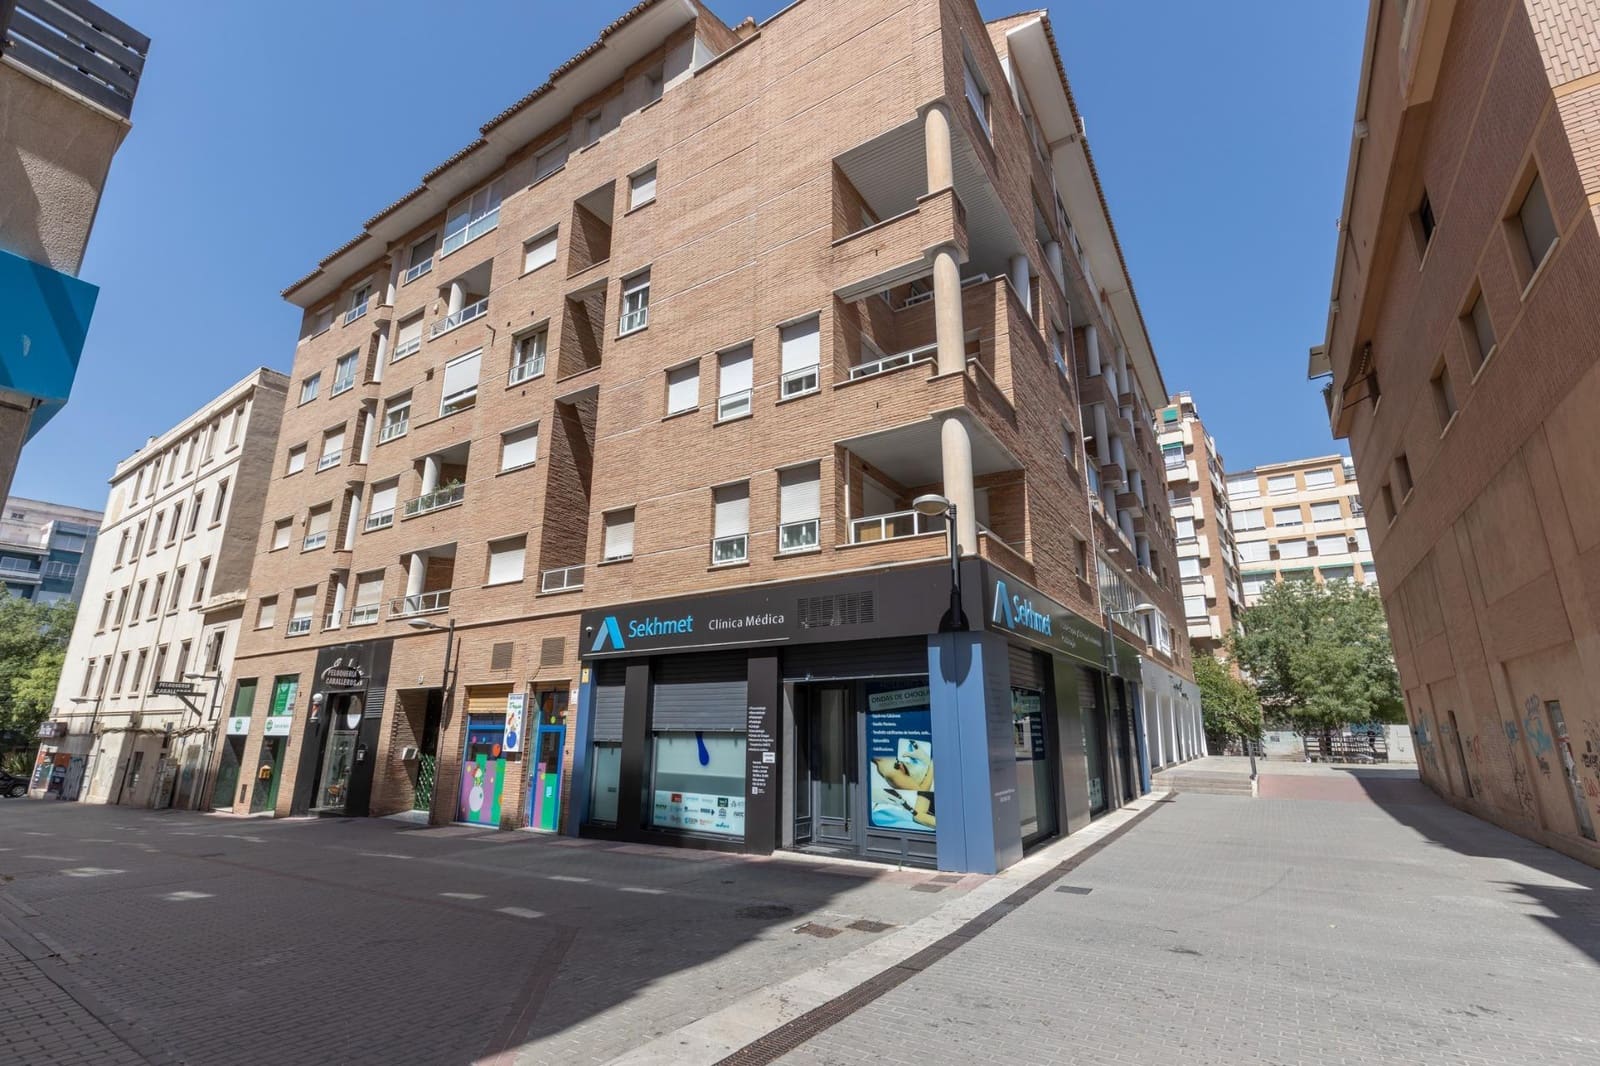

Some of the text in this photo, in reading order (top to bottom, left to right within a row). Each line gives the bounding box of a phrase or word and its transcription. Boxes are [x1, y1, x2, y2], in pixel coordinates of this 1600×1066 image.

[708, 614, 785, 631] Clínica Médica
[1013, 594, 1053, 637] Sekhmet
[628, 615, 694, 638] Sekhmet
[903, 688, 930, 699] CHOQU
